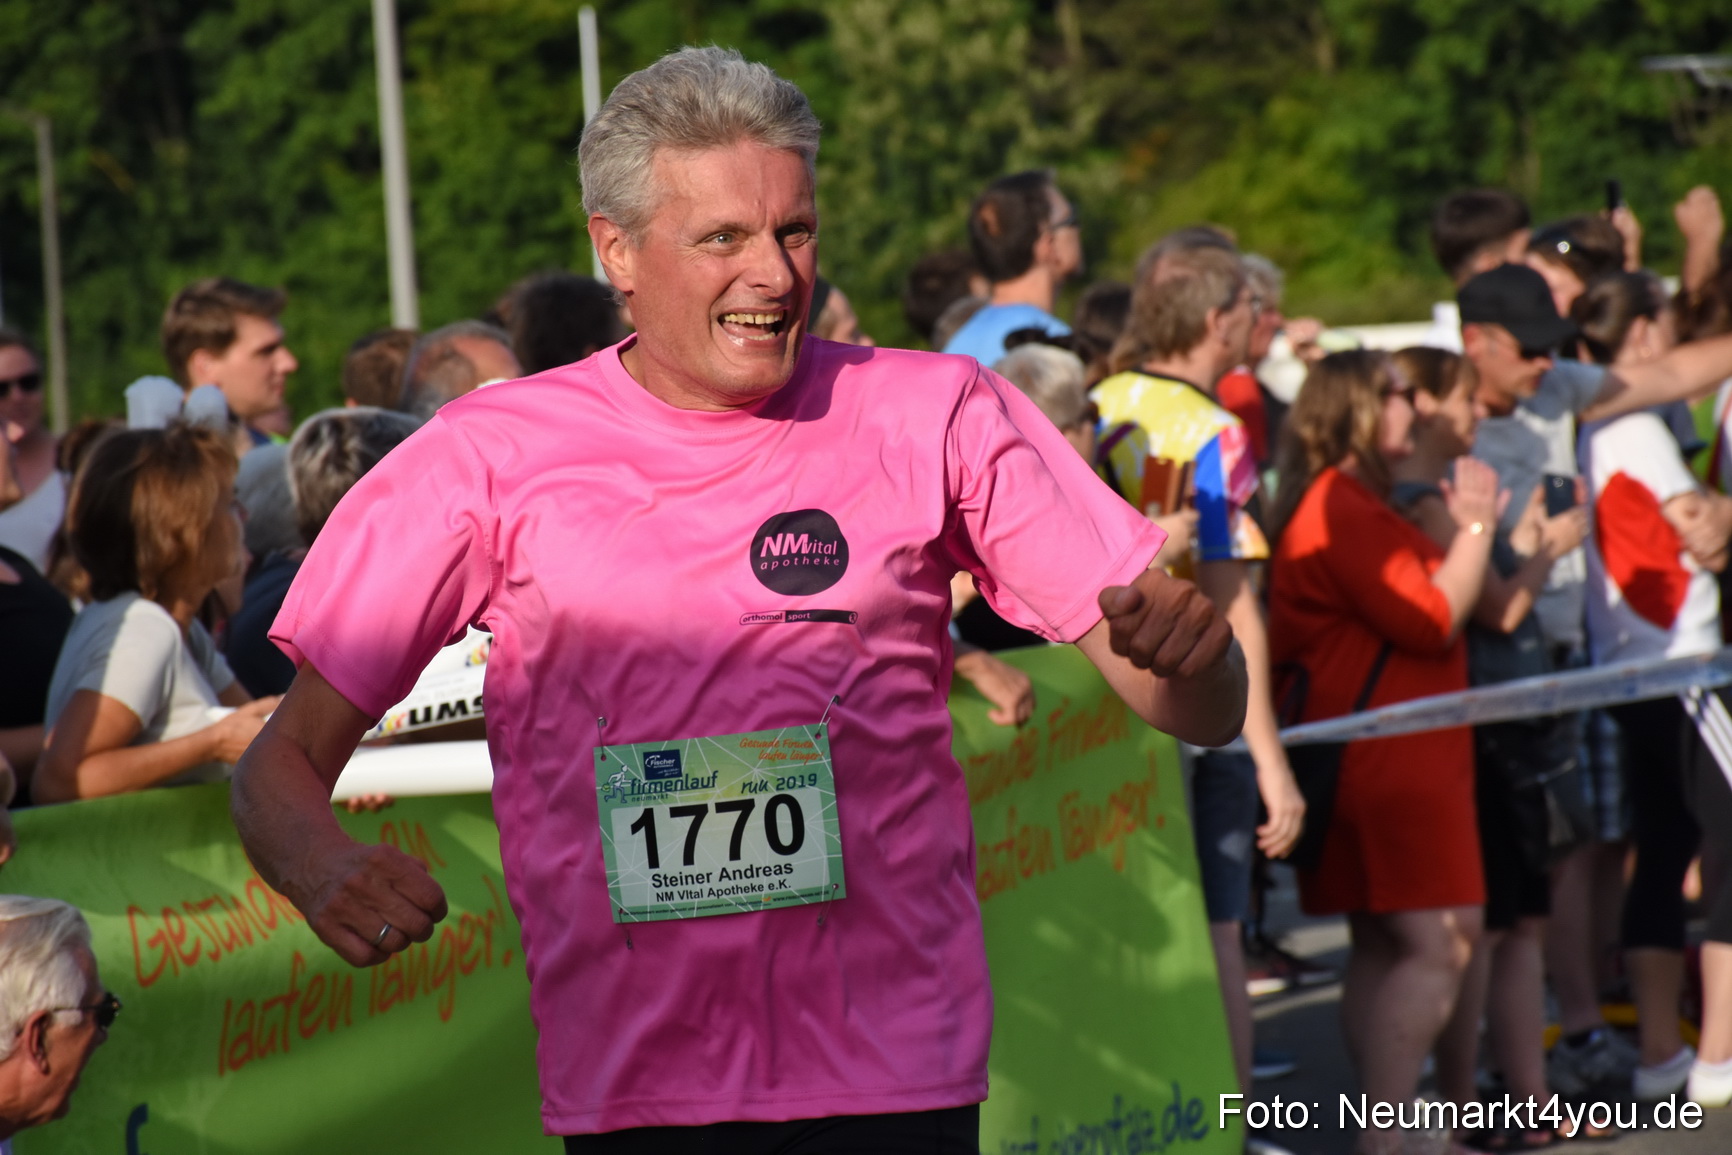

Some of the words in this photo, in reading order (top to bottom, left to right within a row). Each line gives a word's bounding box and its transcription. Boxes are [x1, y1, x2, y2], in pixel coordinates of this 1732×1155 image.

[760, 557, 840, 570] apotheke
[742, 612, 783, 623] orthomol
[787, 612, 811, 621] sport
[630, 770, 719, 796] firmenlauf
[775, 773, 817, 791] 2019
[630, 793, 805, 869] 1770
[651, 871, 713, 888] Steiner
[718, 863, 794, 882] Andreas
[656, 891, 674, 902] NM
[707, 883, 764, 899] Apotheke
[768, 879, 792, 891] e.K.
[127, 868, 306, 988] Gesund
[218, 950, 353, 1078] laufen
